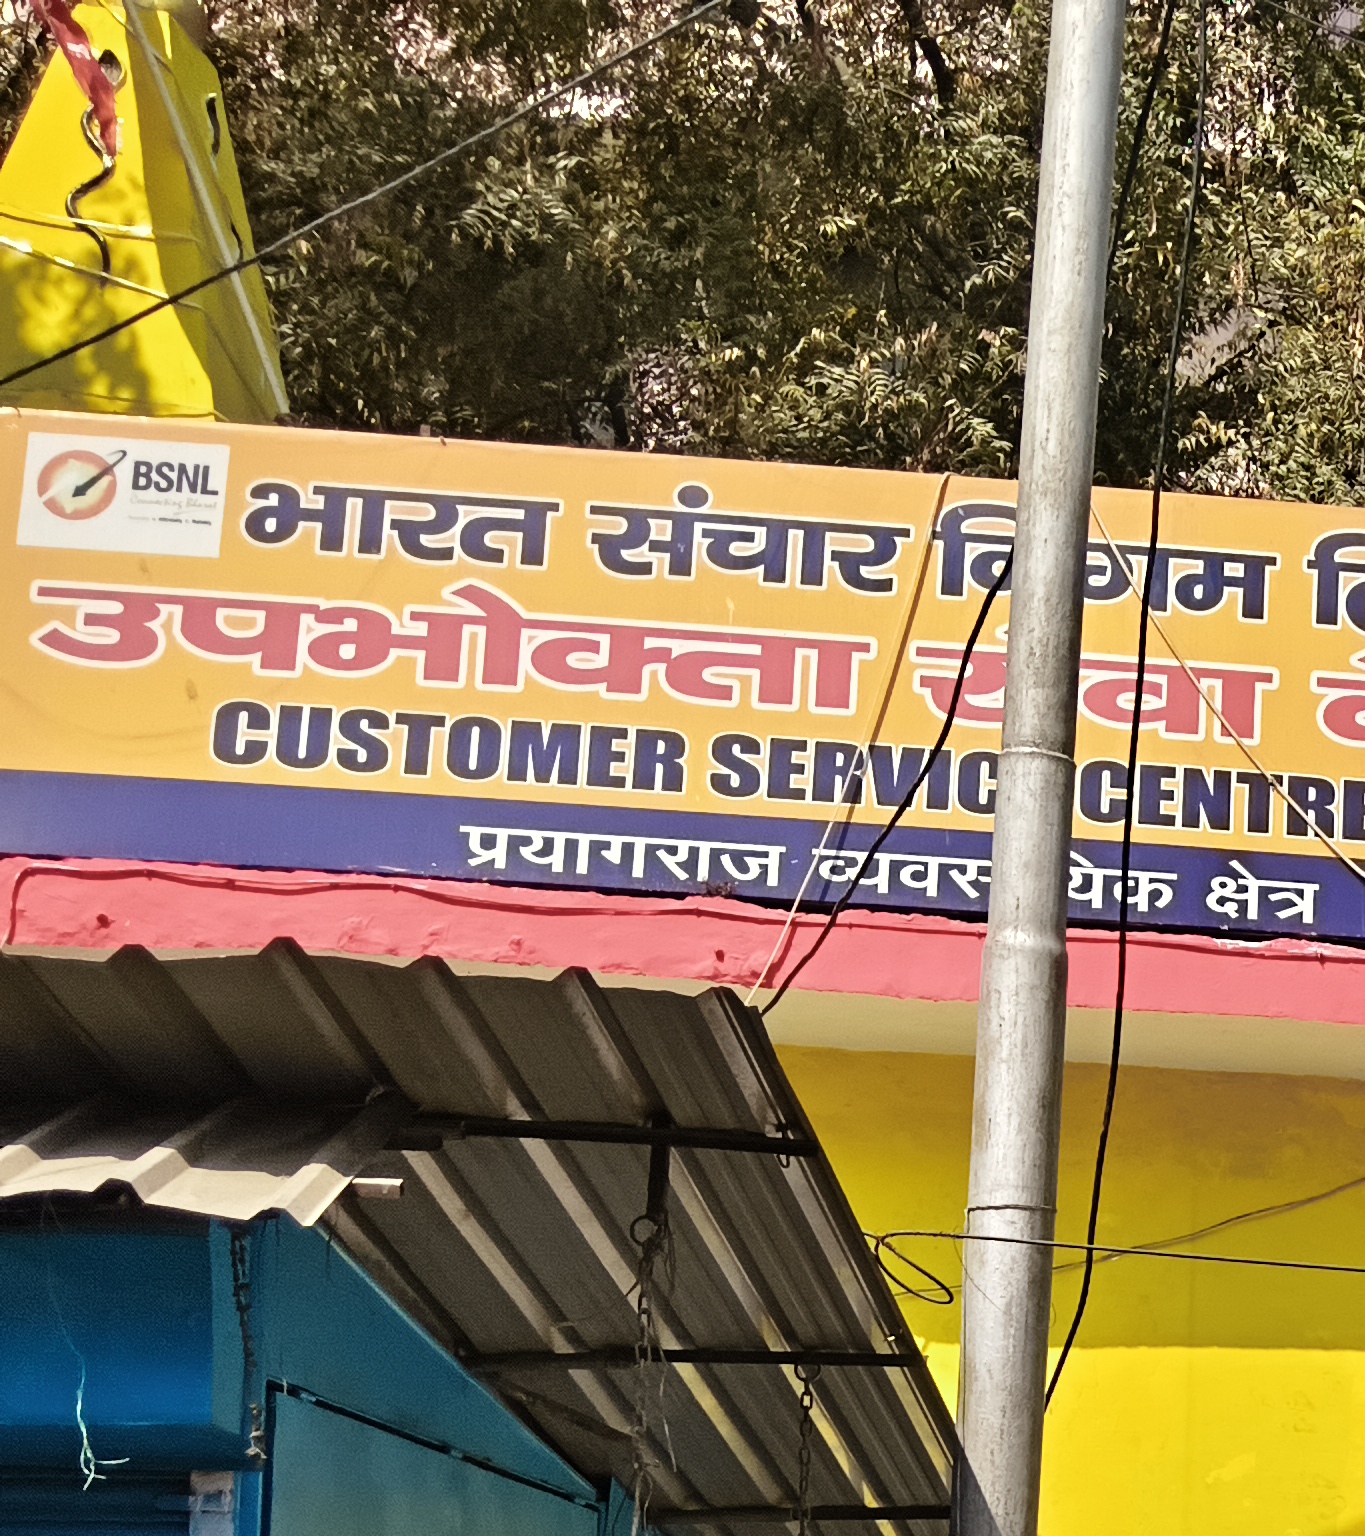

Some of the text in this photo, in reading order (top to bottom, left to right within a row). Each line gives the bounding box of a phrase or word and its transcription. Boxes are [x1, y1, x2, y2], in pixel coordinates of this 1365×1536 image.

[132, 461, 219, 495] BSNL
[243, 481, 562, 568] भारत
[587, 484, 911, 595] संचार
[30, 579, 877, 715] उपभोक्ता
[910, 634, 1279, 745] सवा
[211, 699, 687, 795] CUSTOMER
[708, 733, 999, 816] SERVIC
[459, 823, 786, 888] प्रयागराज
[1207, 858, 1320, 925] क्षेत्र
